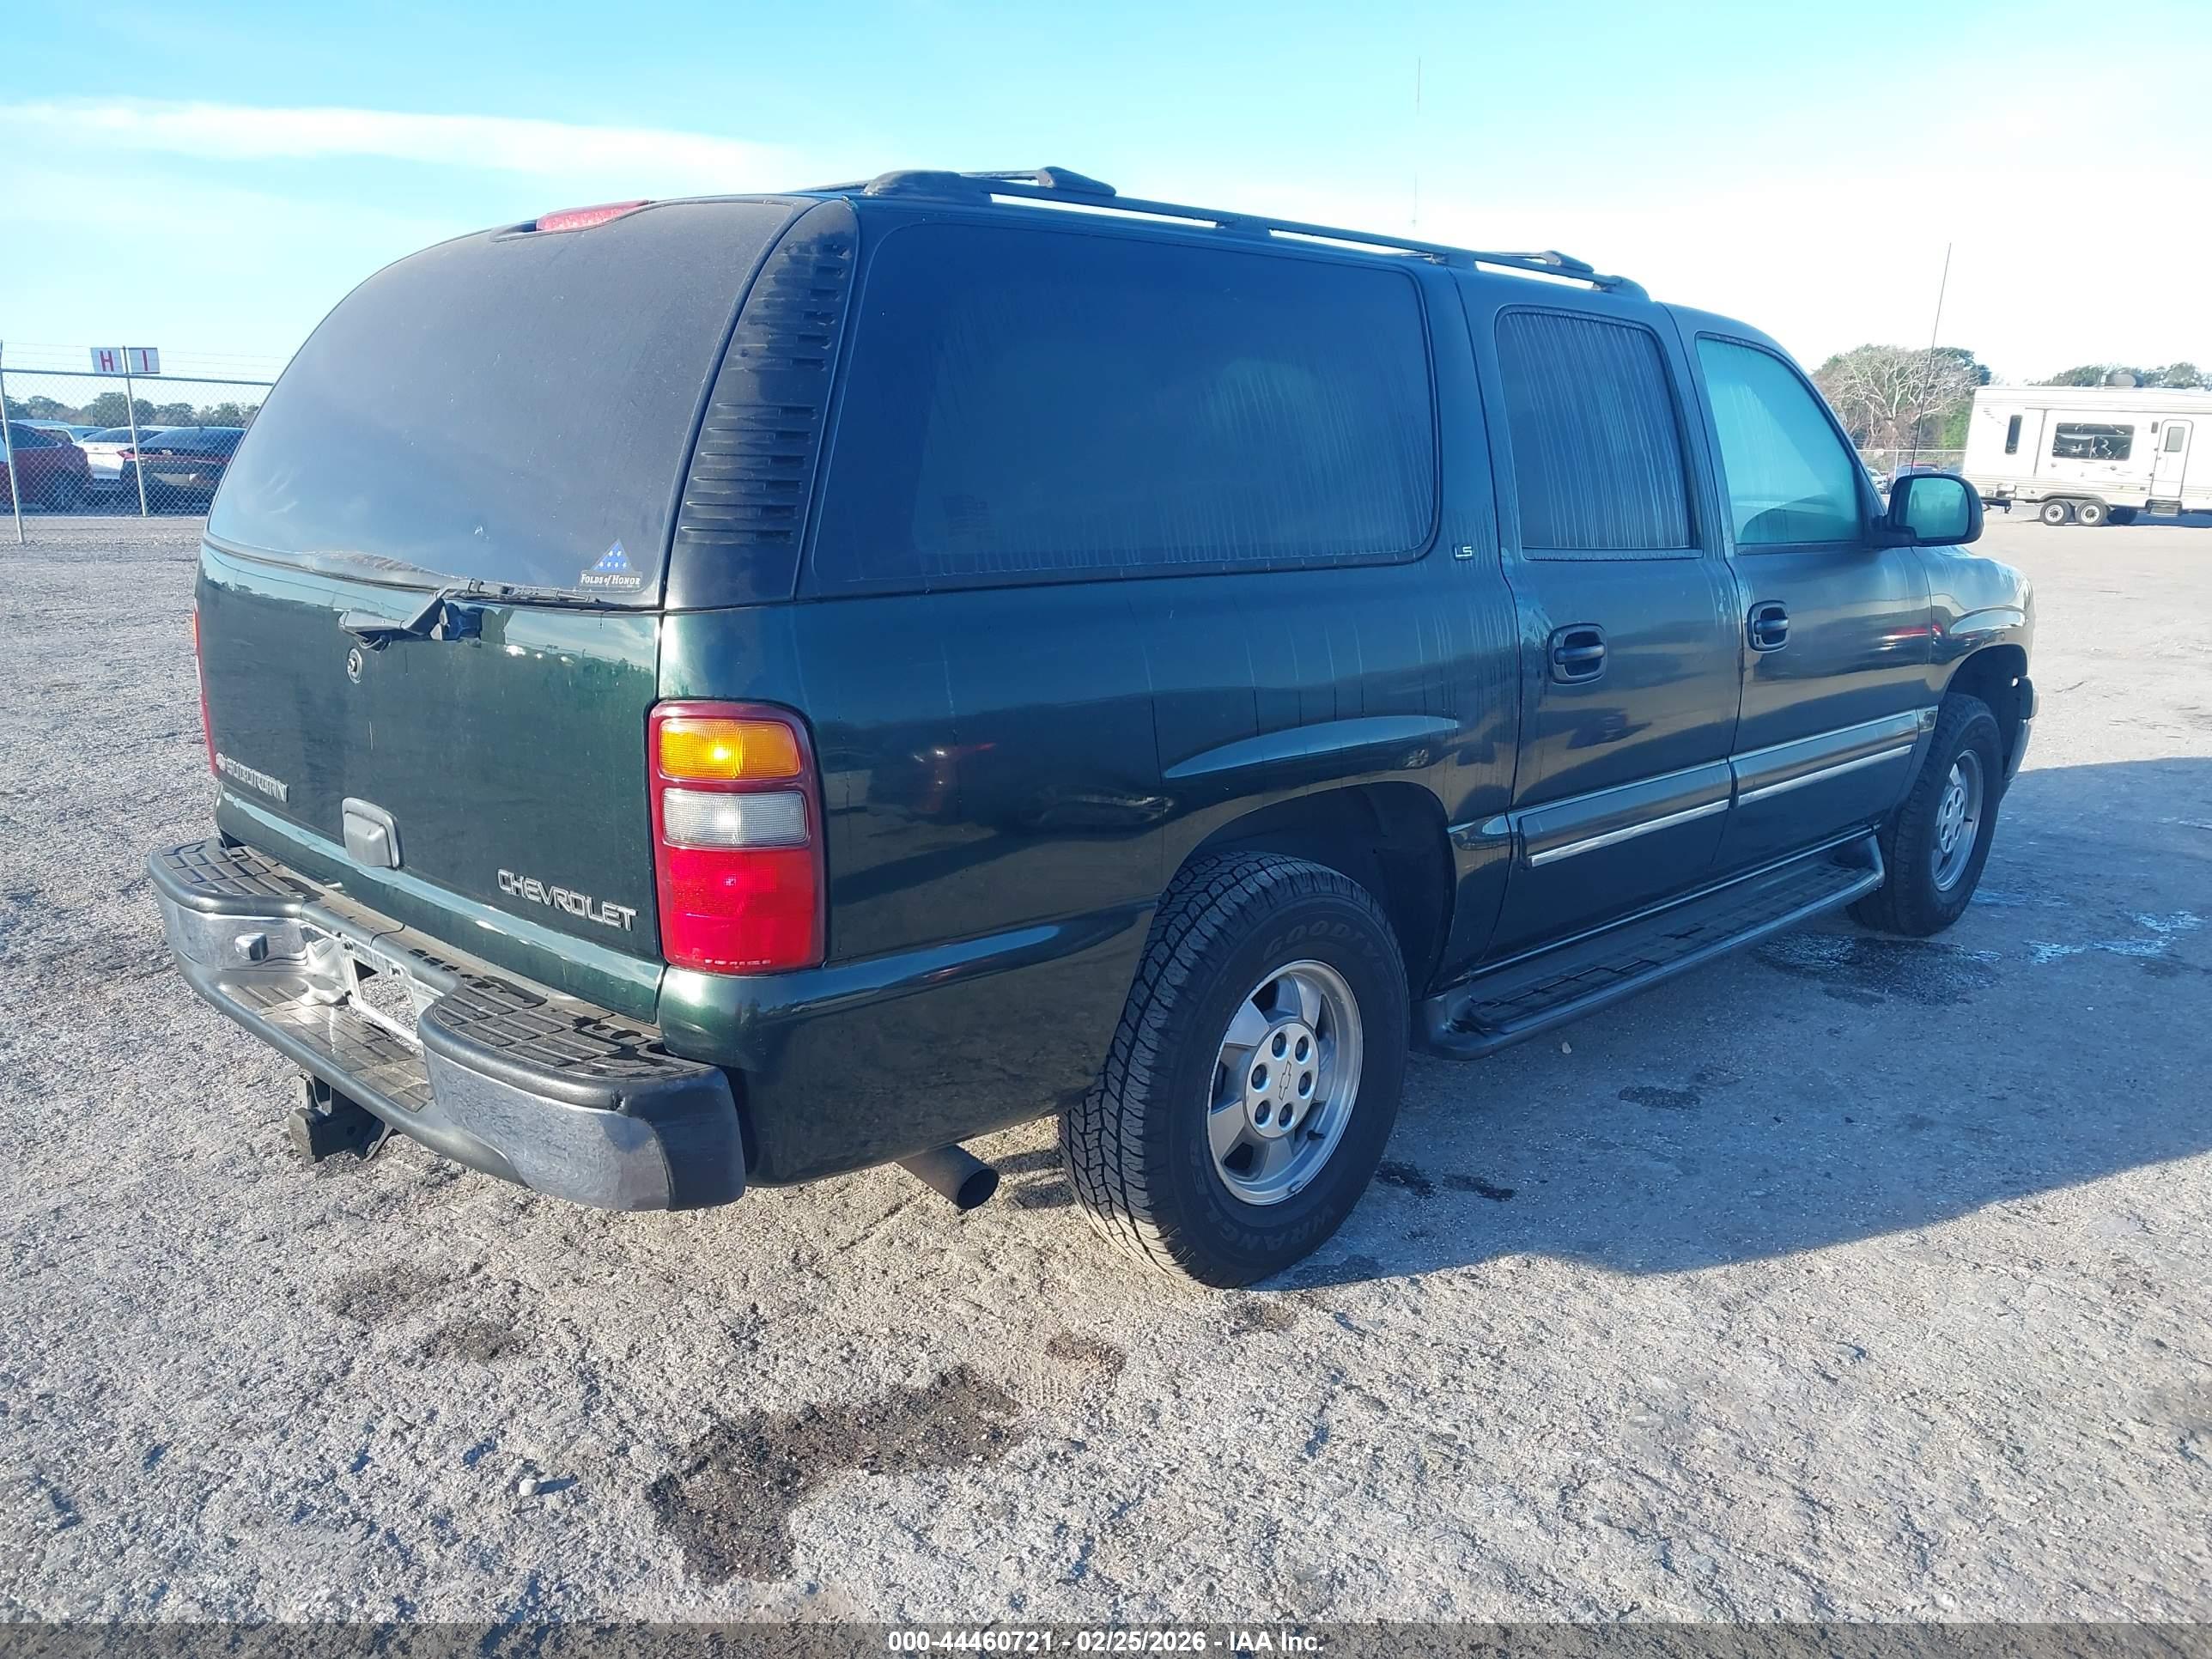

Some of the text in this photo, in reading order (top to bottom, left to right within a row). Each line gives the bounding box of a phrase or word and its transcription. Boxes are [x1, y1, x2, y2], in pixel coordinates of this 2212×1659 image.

[99, 349, 114, 372] H
[1455, 545, 1473, 557] LS
[604, 574, 612, 586] of
[611, 574, 641, 585] HONOR
[497, 868, 638, 933] CHEVROLET
